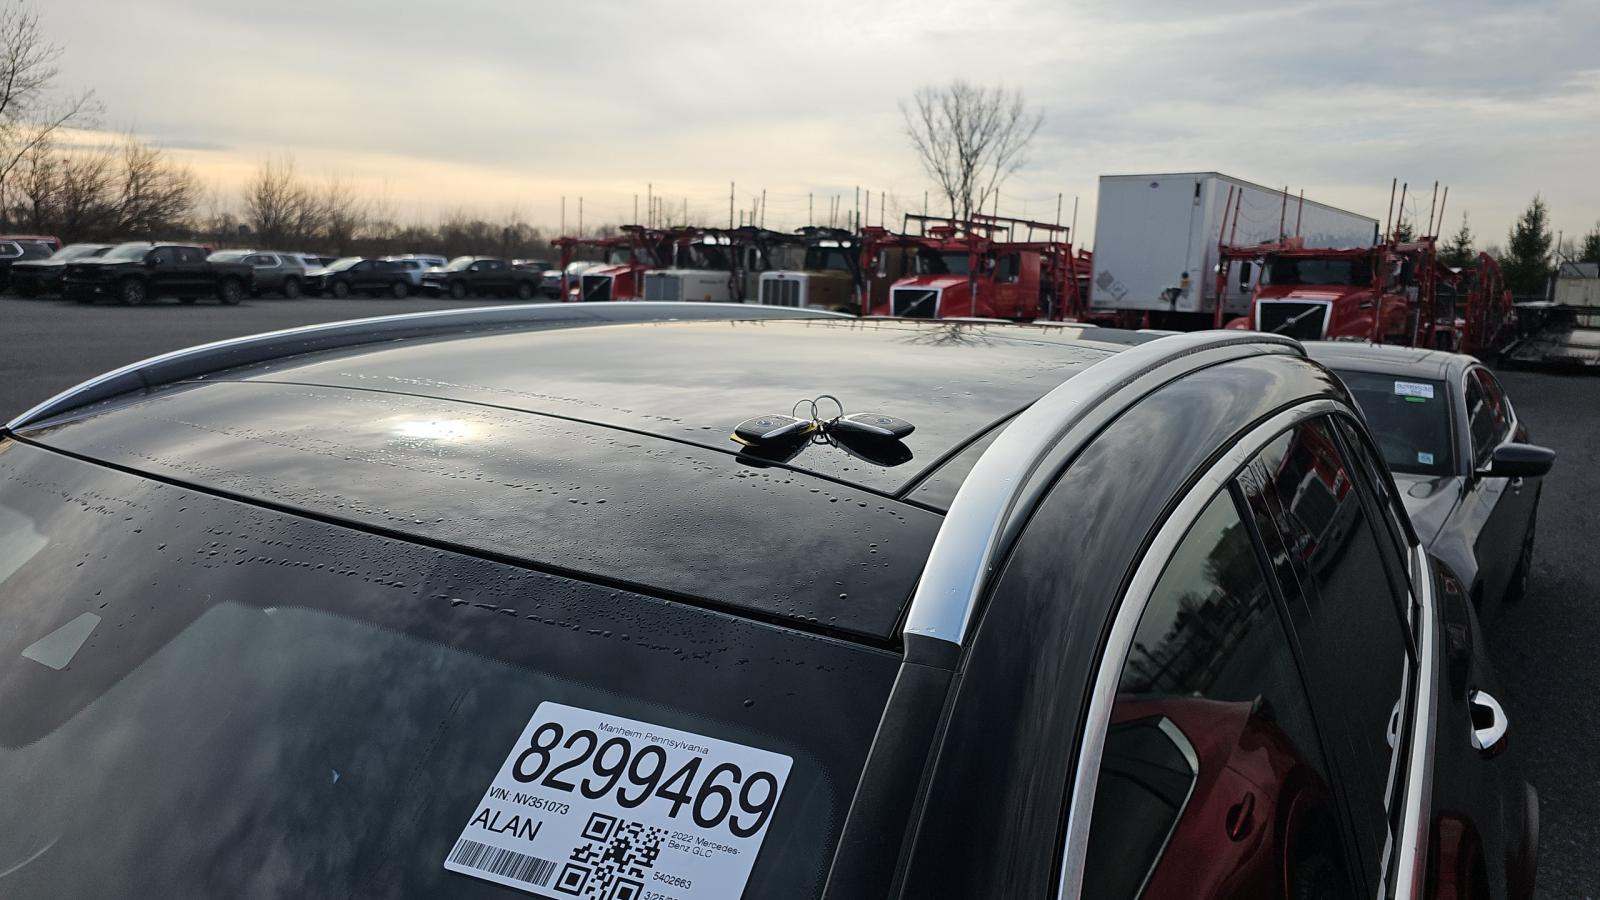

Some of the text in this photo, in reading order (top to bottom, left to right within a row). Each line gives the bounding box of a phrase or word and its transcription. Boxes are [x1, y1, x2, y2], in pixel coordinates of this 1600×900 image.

[598, 722, 709, 755] Manheim Pennsylvania
[512, 722, 777, 838] 8299469
[489, 786, 570, 815] VIN: NV351073
[470, 808, 543, 841] ALAN
[667, 840, 713, 858] Benz GLC
[671, 831, 741, 855] 2022 Mercedes-
[652, 871, 692, 889] 5402663
